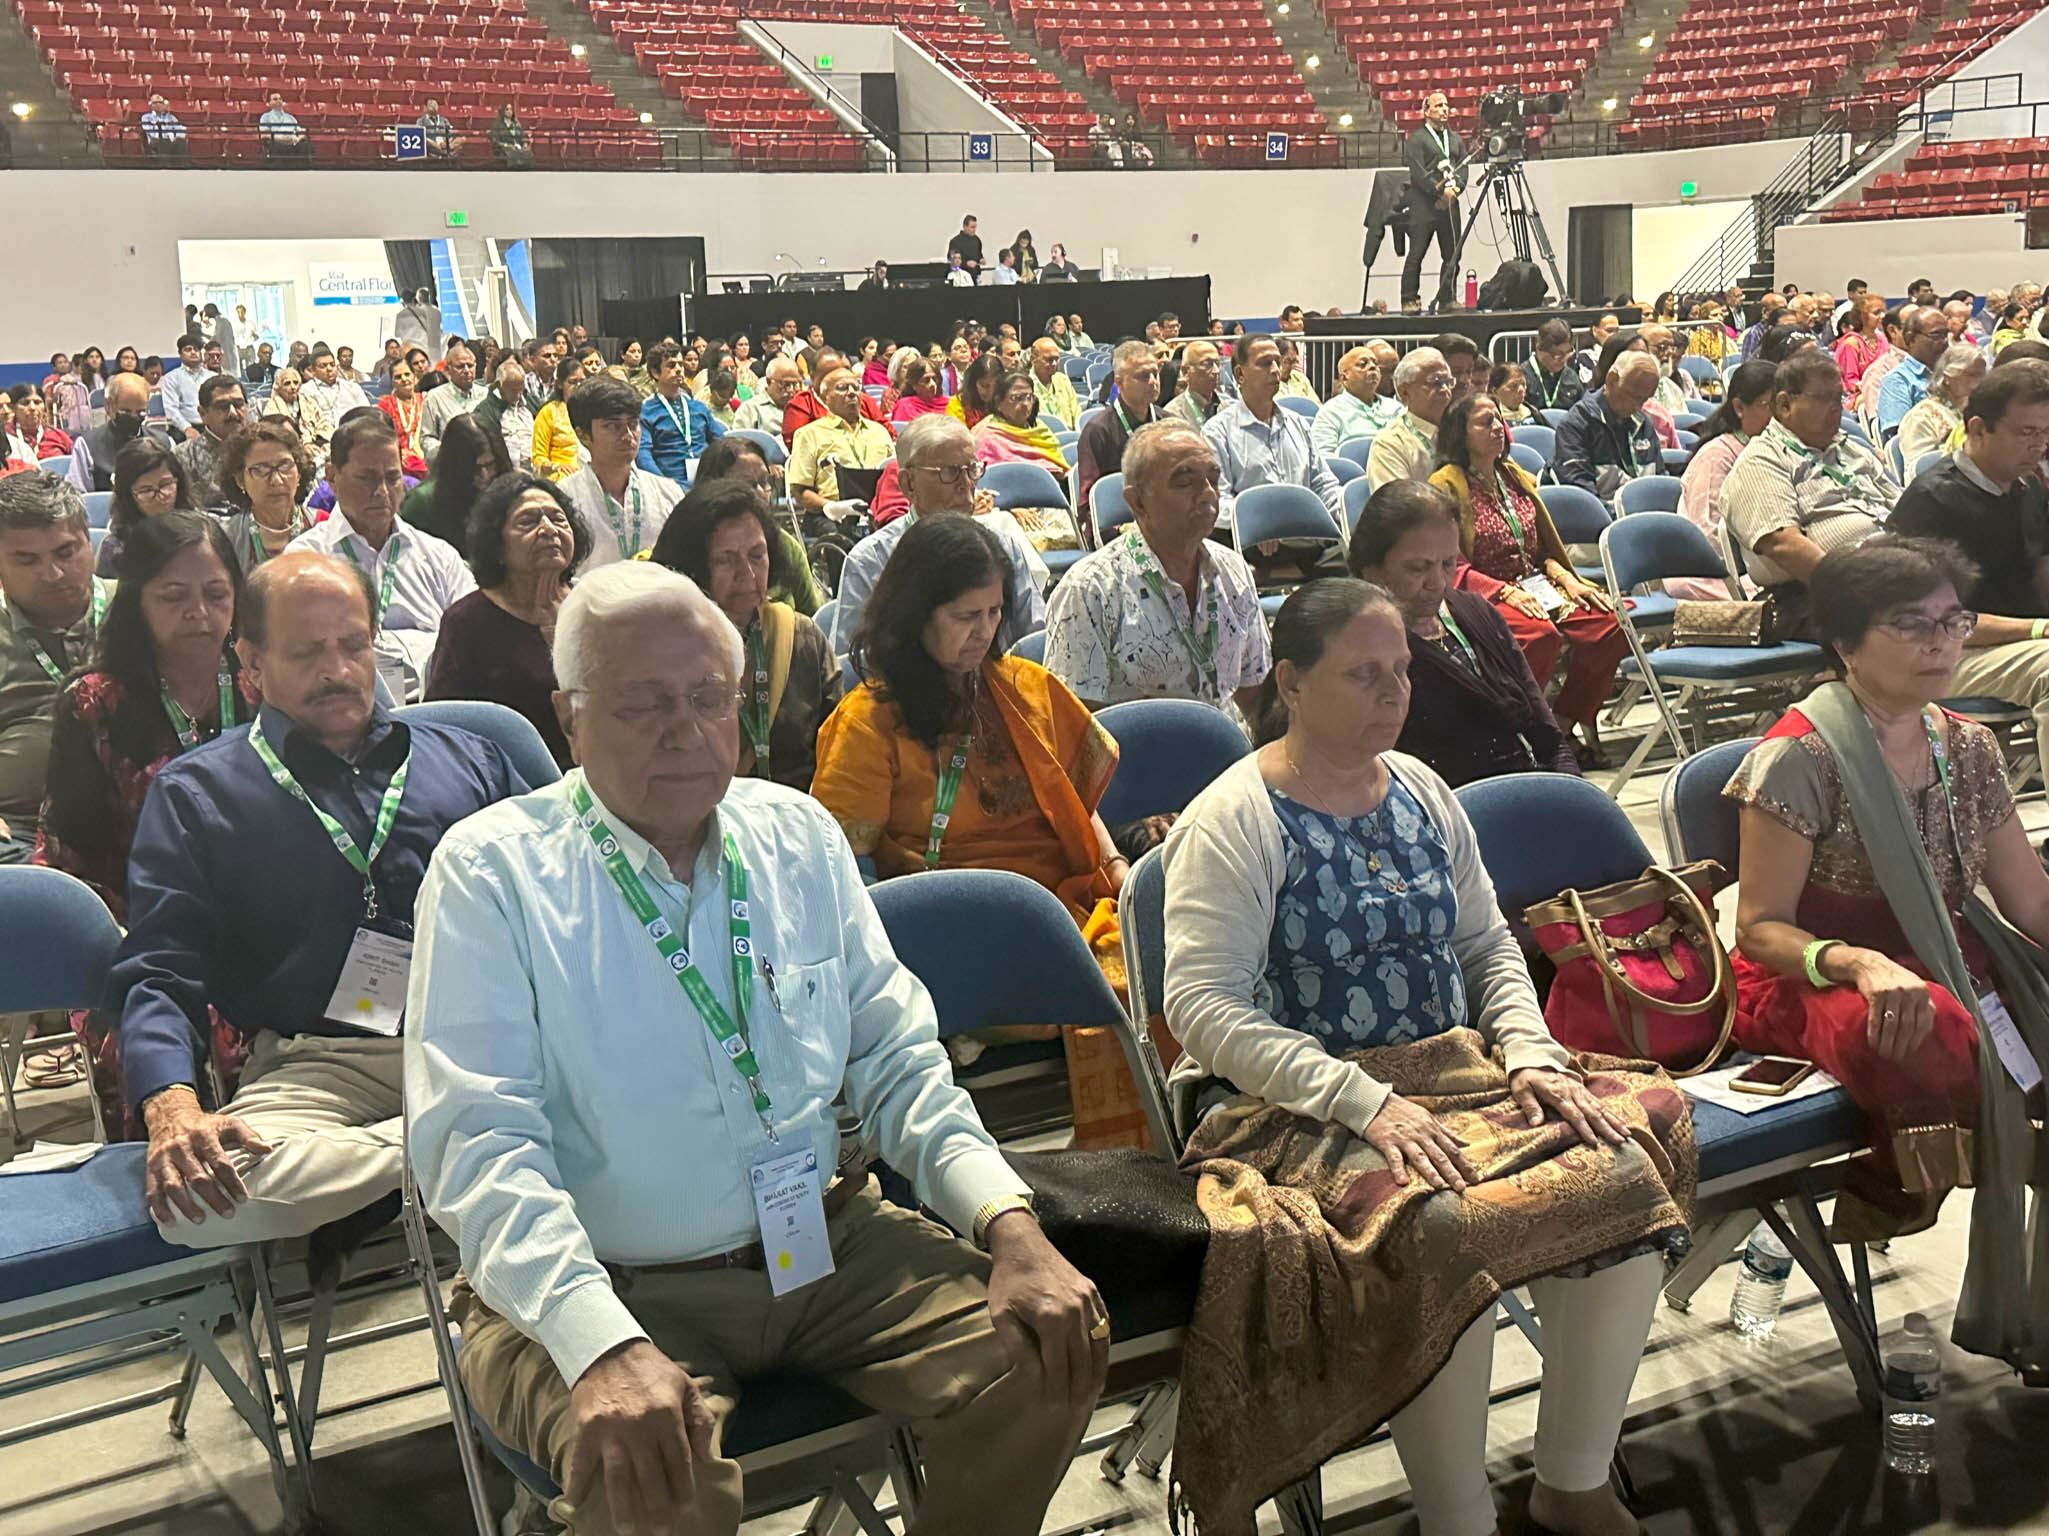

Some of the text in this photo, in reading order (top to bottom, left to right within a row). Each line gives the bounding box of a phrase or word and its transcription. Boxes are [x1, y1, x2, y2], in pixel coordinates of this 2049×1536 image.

[401, 135, 422, 150] 32
[972, 141, 989, 154] 33
[1269, 141, 1284, 154] 34
[319, 277, 367, 291] Central
